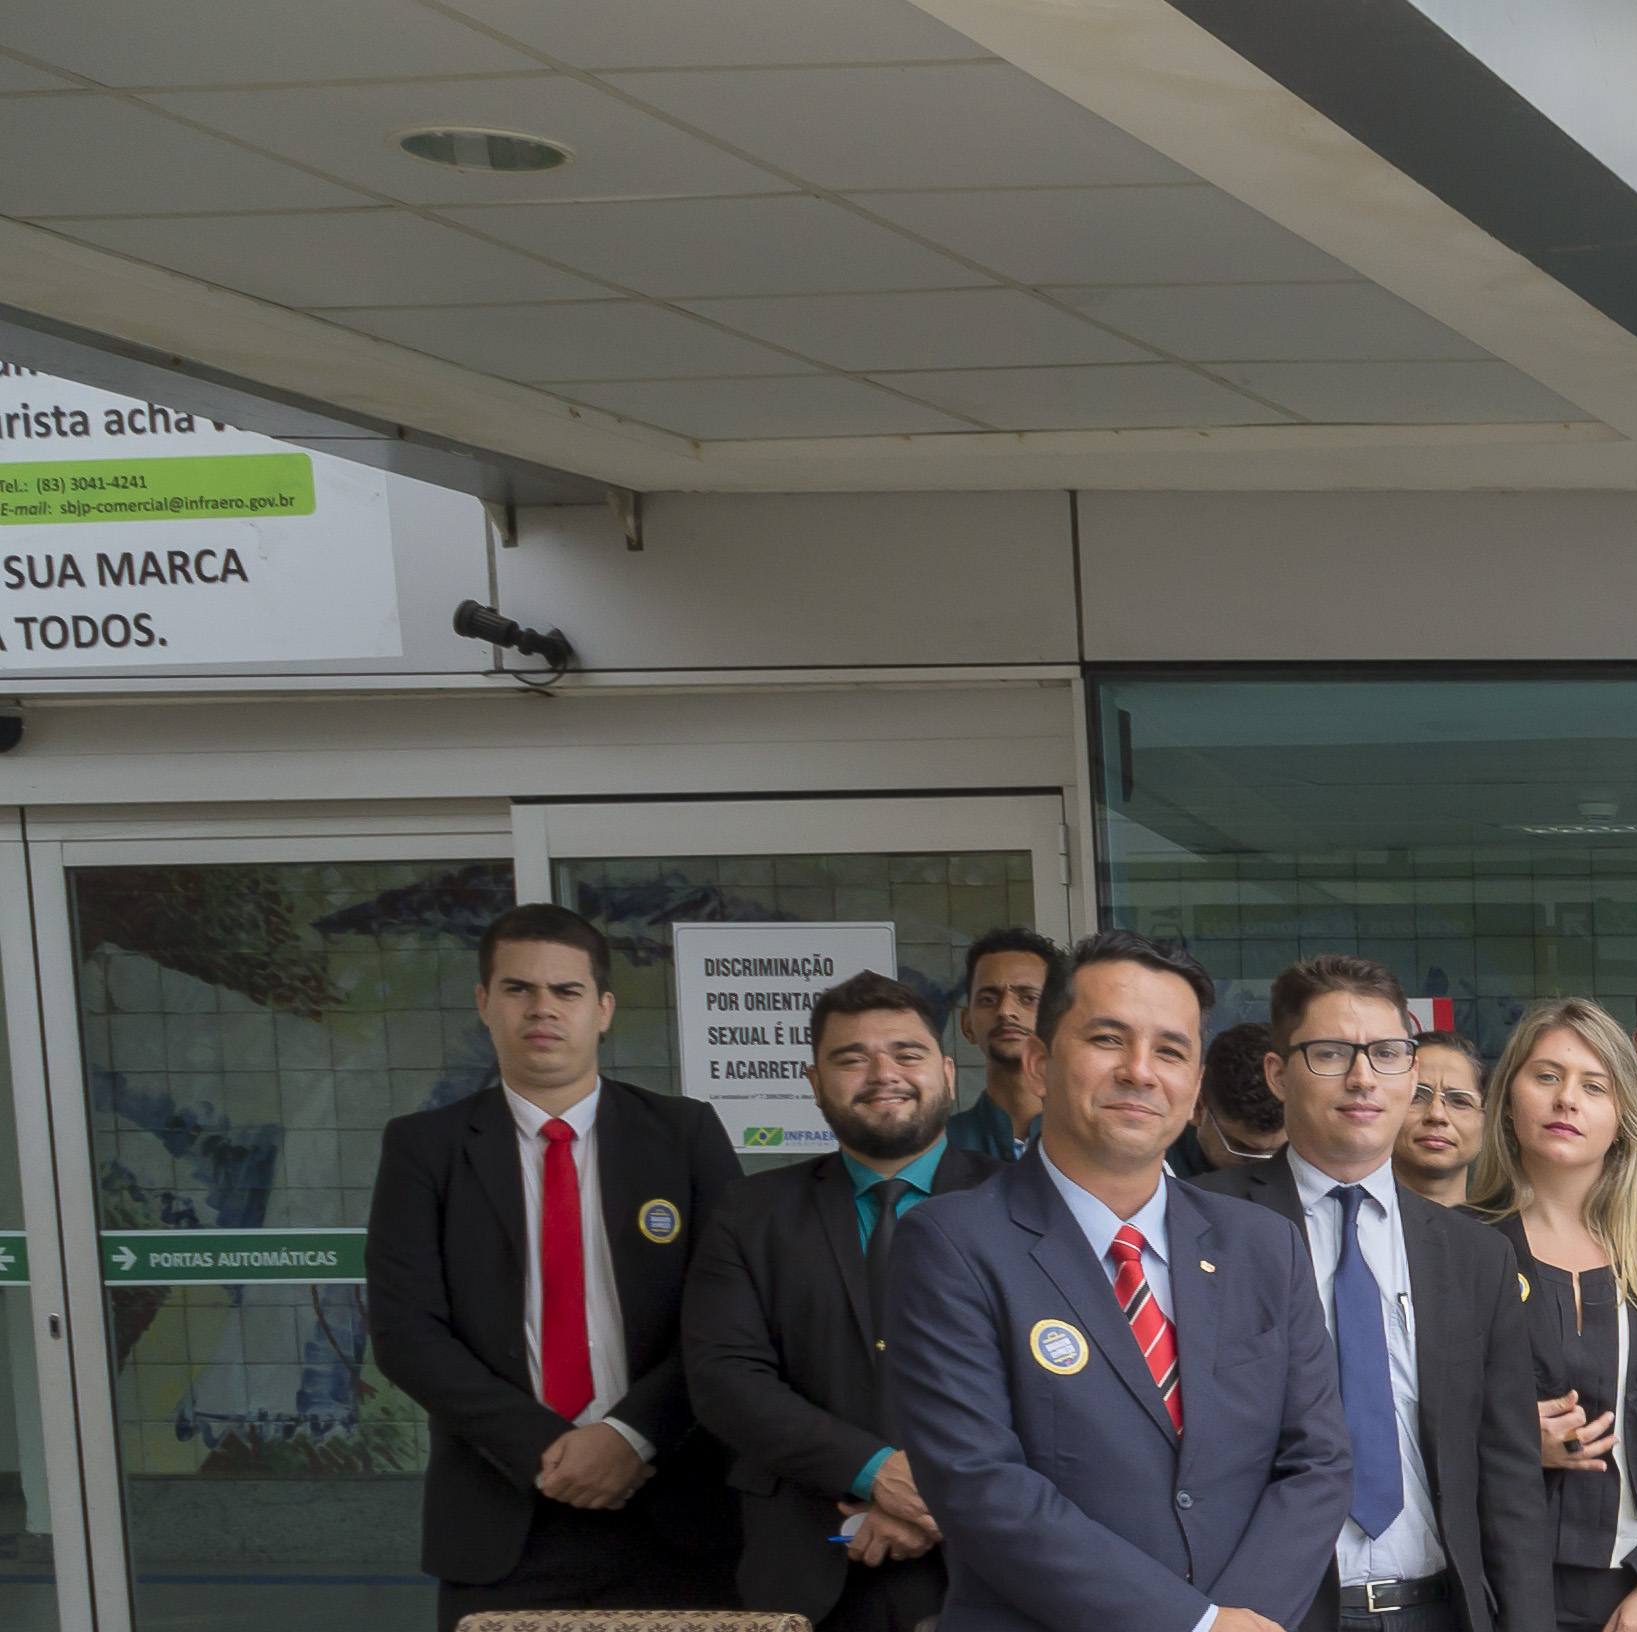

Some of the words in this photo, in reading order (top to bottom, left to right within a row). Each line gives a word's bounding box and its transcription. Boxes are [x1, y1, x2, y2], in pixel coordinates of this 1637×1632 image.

[0, 403, 90, 439] rista
[37, 478, 65, 494] (83)
[71, 475, 147, 492] 3041-4241
[1, 502, 52, 517] E-mail:
[60, 494, 295, 517] sbjp-comercial@infraero.gov.br
[4, 553, 86, 590] SUA
[97, 549, 249, 587] MARCA
[14, 613, 167, 651] TODOS.
[704, 953, 834, 982] DISCRIMINAÇÃO
[707, 993, 739, 1012] POR
[708, 1027, 770, 1046] SEXUAL
[775, 1021, 784, 1045] É
[711, 1061, 720, 1079] E
[726, 1061, 808, 1079] ACARRETA
[149, 1252, 214, 1268] PORTAS
[218, 1247, 337, 1267] AUTOMÁTICAS
